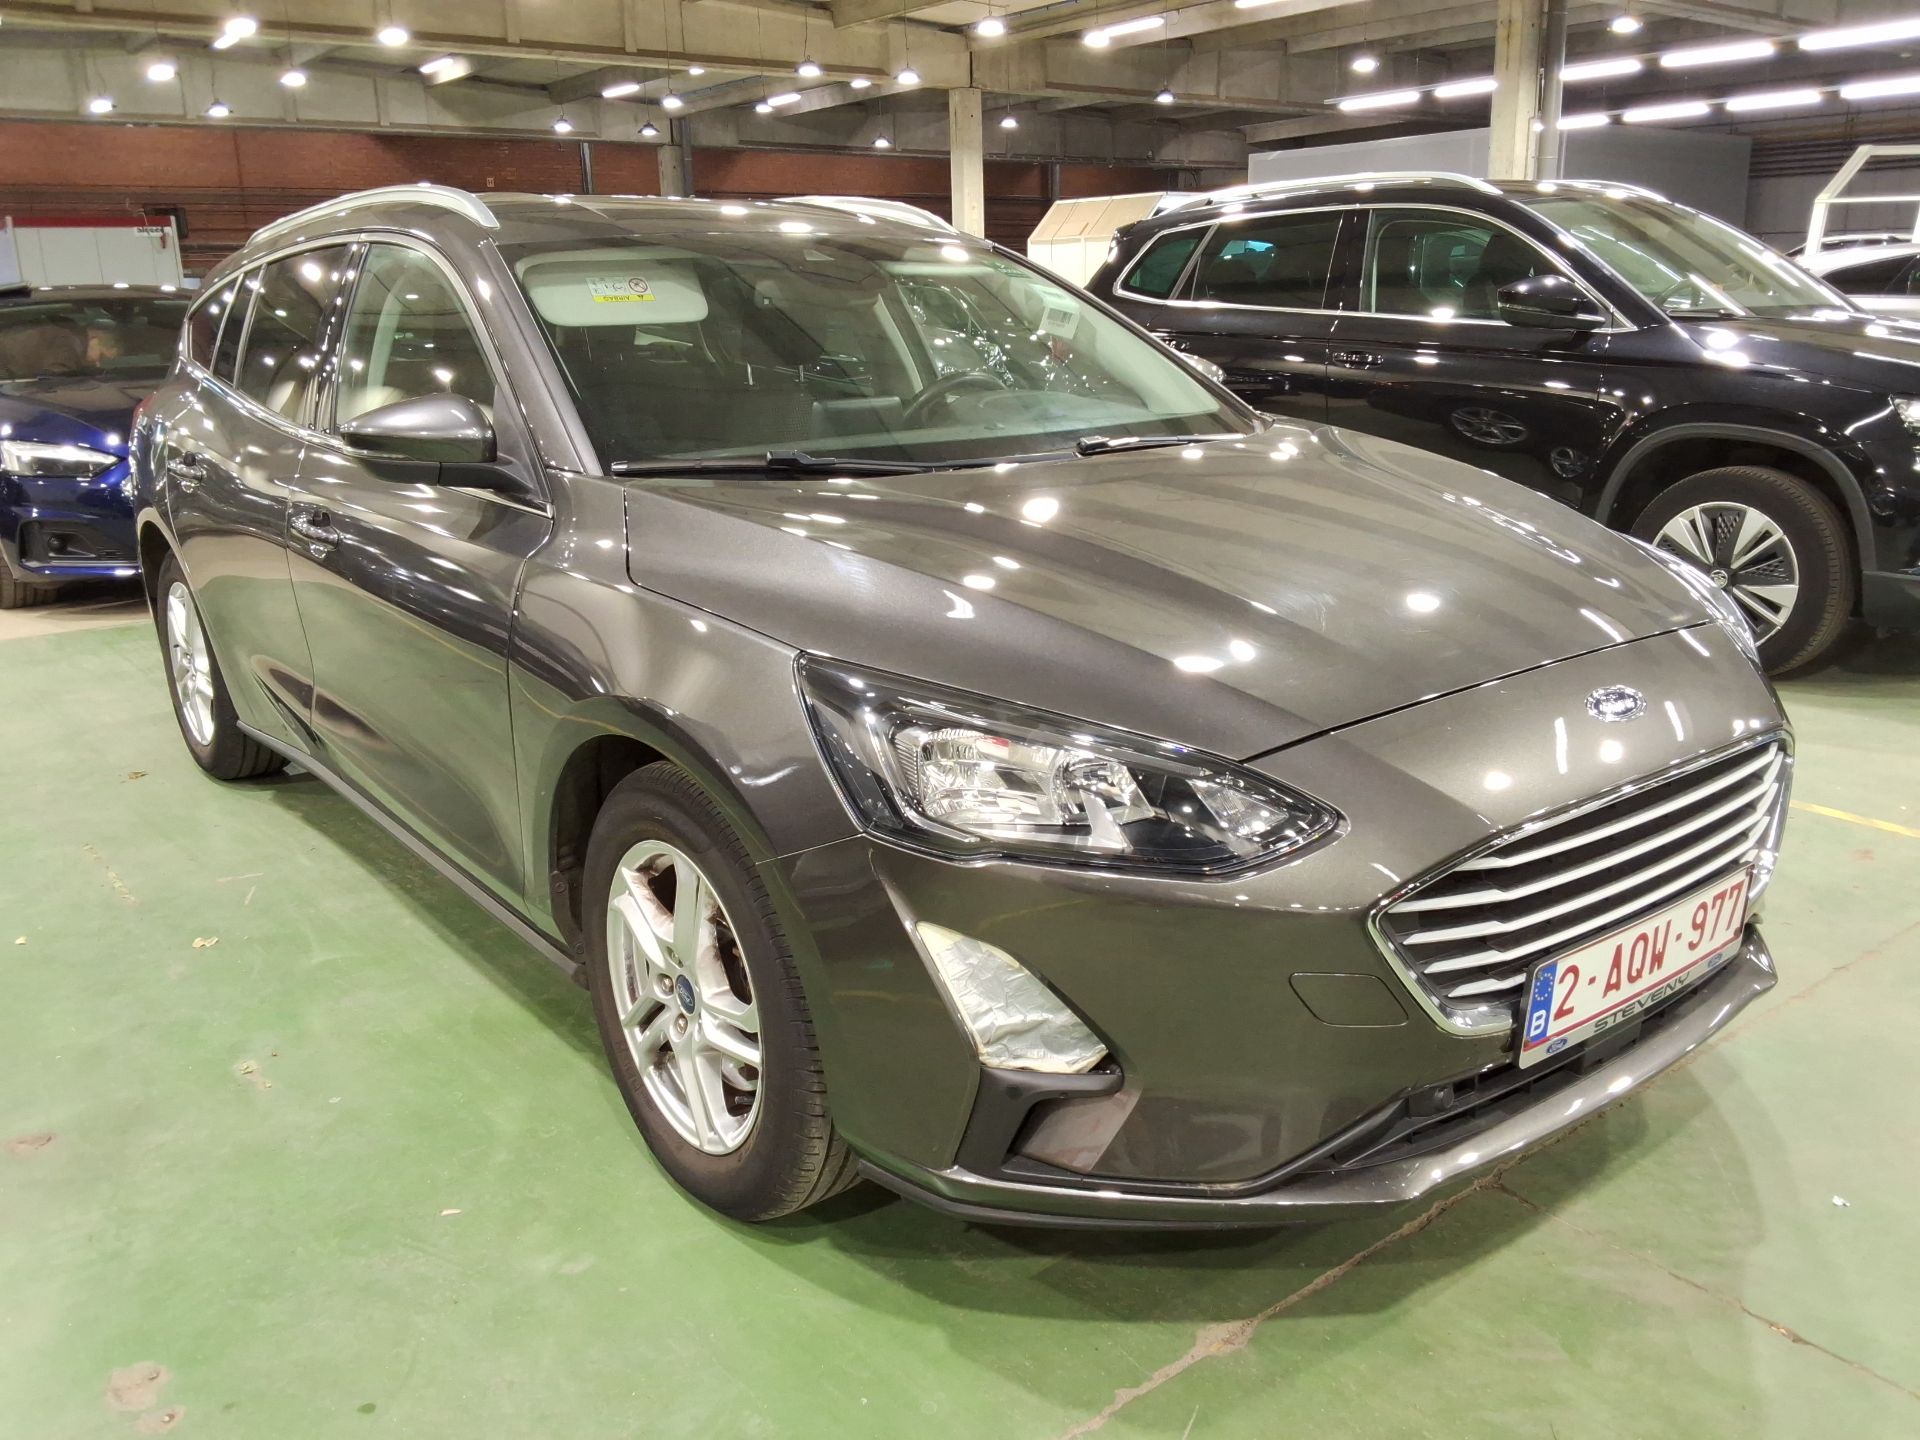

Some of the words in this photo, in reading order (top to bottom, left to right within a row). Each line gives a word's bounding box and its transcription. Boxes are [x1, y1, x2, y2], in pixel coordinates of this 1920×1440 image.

[1553, 879, 1745, 1021] 2-AQW-977
[1530, 1010, 1546, 1037] B
[1594, 971, 1689, 1033] STEVENY
